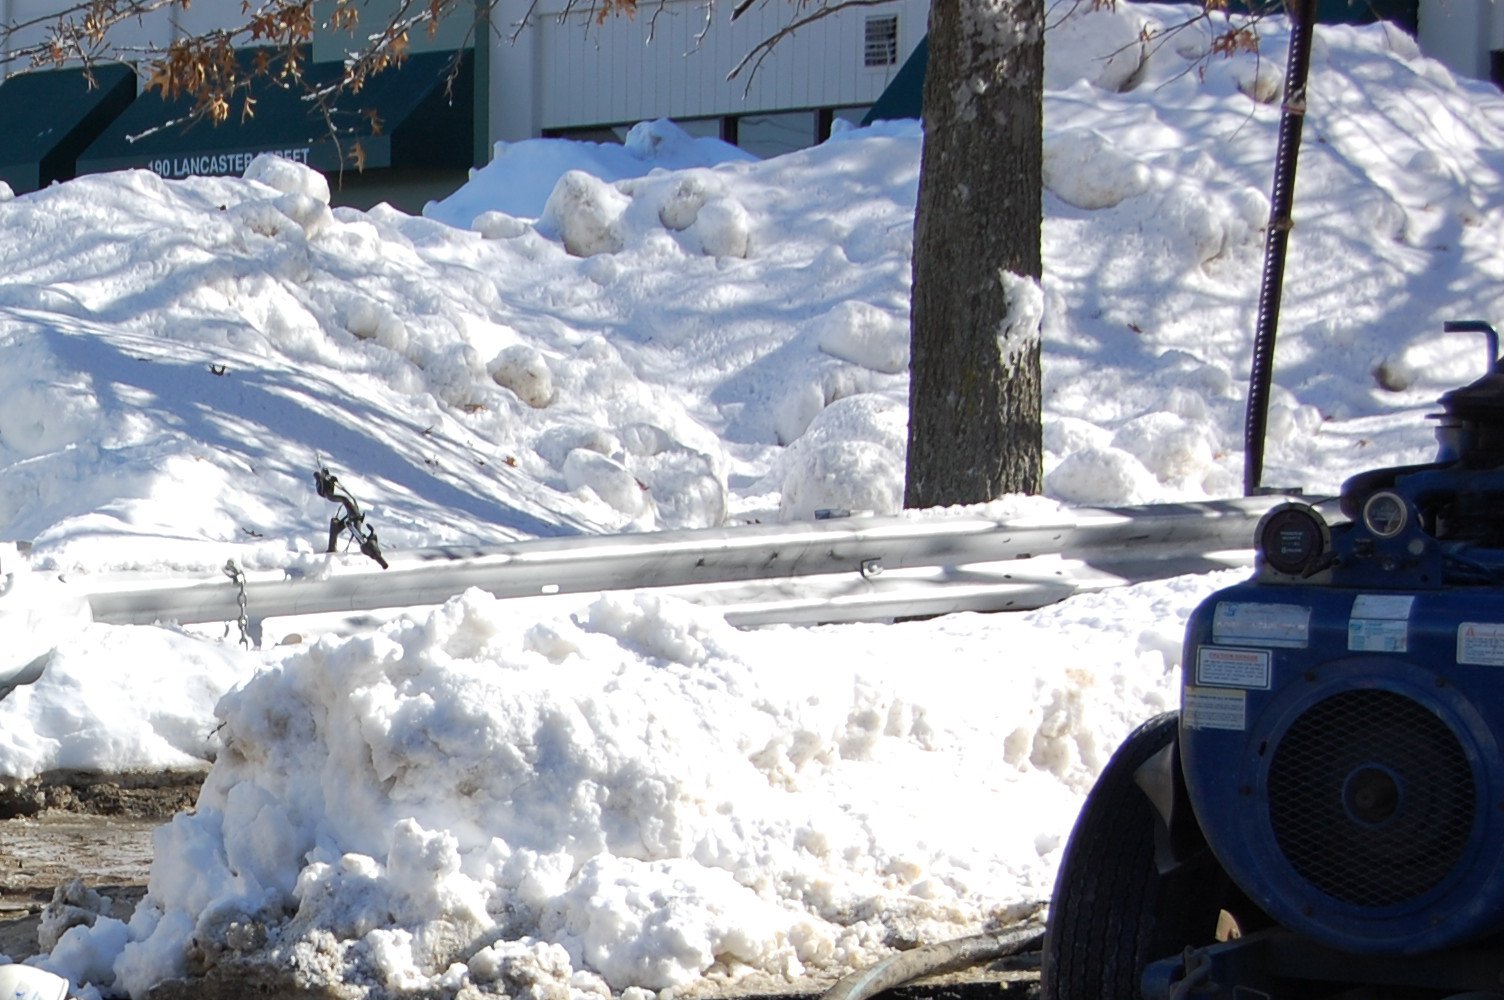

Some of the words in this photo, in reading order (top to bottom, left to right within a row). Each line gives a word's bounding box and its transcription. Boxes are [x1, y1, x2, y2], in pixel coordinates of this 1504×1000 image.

[148, 159, 170, 177] 190
[173, 152, 254, 177] LANCASTER
[258, 147, 310, 165] EET
